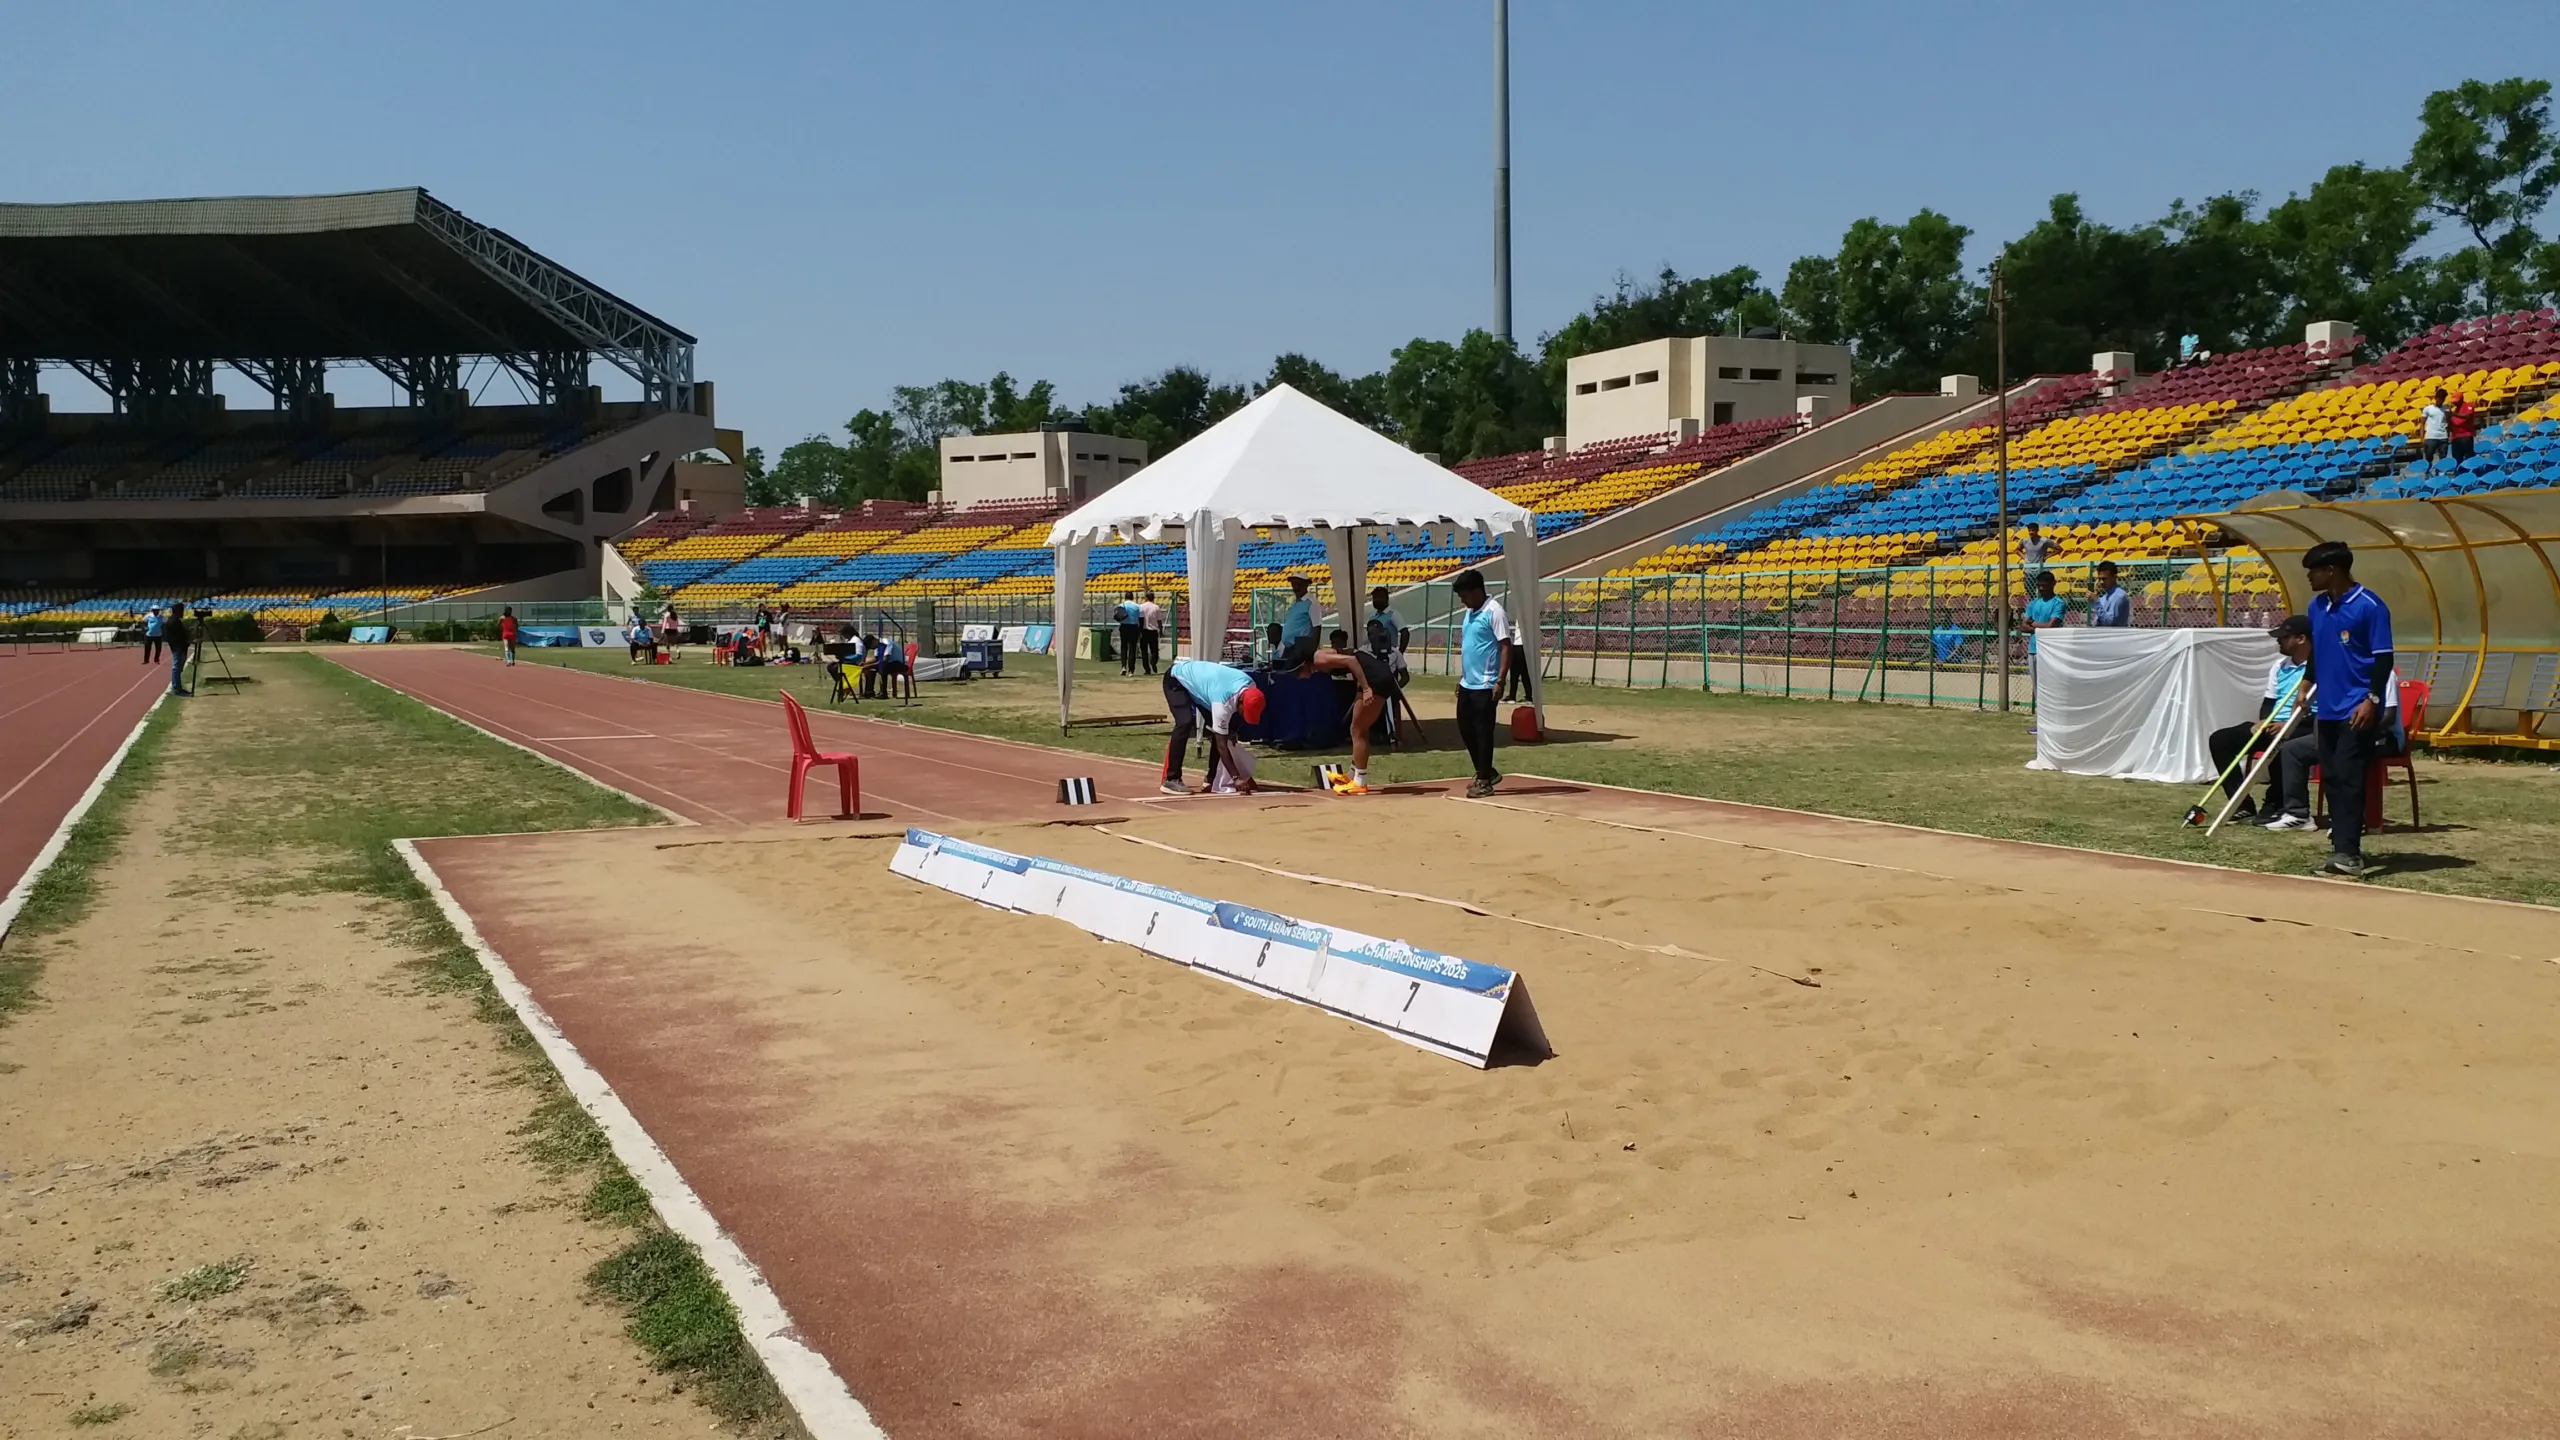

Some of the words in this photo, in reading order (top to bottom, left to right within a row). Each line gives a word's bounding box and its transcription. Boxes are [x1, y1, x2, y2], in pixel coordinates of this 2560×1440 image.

[919, 852, 930, 869] 2
[1060, 864, 1081, 877] ATHLETICS
[982, 870, 993, 889] 3
[1123, 880, 1137, 891] SAAF
[1135, 883, 1154, 895] SENIOR
[1152, 887, 1178, 902] ATHLETICS
[1057, 886, 1066, 907] 4
[1146, 911, 1159, 936] 5
[1243, 915, 1267, 931] SOUTH
[1266, 921, 1291, 936] ASIAN
[1291, 925, 1321, 944] SENIOR
[1257, 941, 1271, 968] 6
[1363, 943, 1441, 974] CHAMPIONSHIPS
[1440, 962, 1469, 981] 2025
[1402, 981, 1421, 1012] 7
